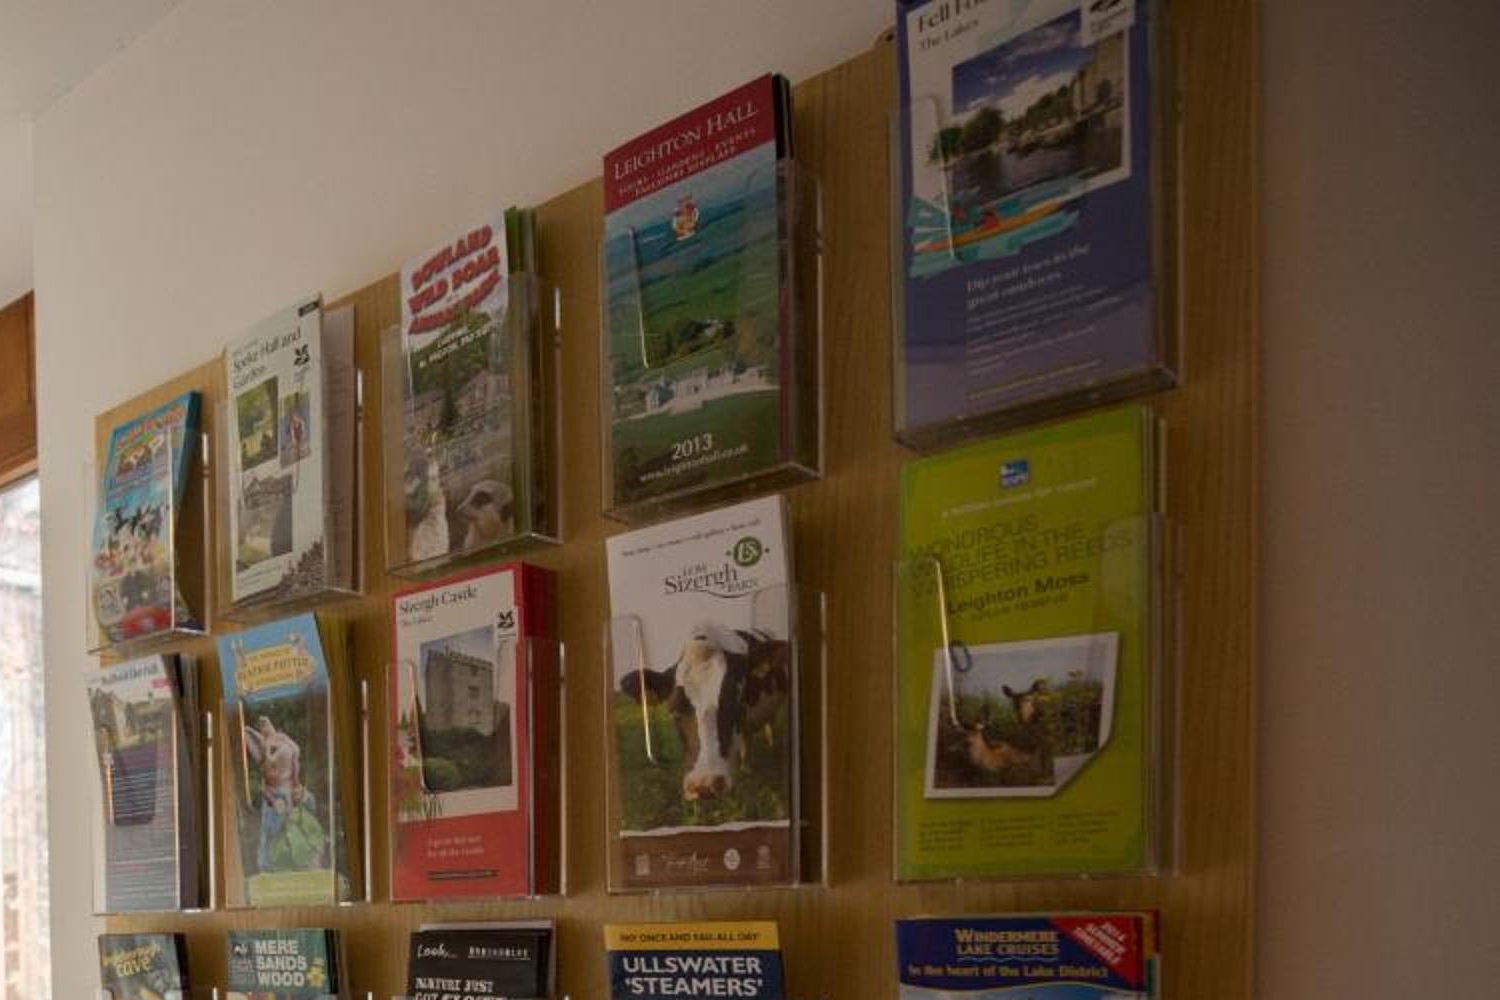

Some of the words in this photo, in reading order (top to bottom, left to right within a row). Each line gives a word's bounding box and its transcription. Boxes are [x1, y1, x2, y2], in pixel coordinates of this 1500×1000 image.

[614, 127, 702, 181] LEIGHTON
[707, 101, 759, 137] HALL
[672, 432, 714, 460] 2013
[664, 563, 738, 593] Sizergh
[955, 928, 1058, 943] WINDERMERE
[255, 940, 298, 954] MERE
[957, 943, 992, 955] LAKE
[996, 944, 1059, 956] CRUISES
[256, 956, 307, 971] SANDS
[622, 956, 763, 975] ULLSWATER
[1022, 964, 1054, 977] Lake
[257, 972, 305, 987] WOOD
[463, 979, 494, 993] JUST
